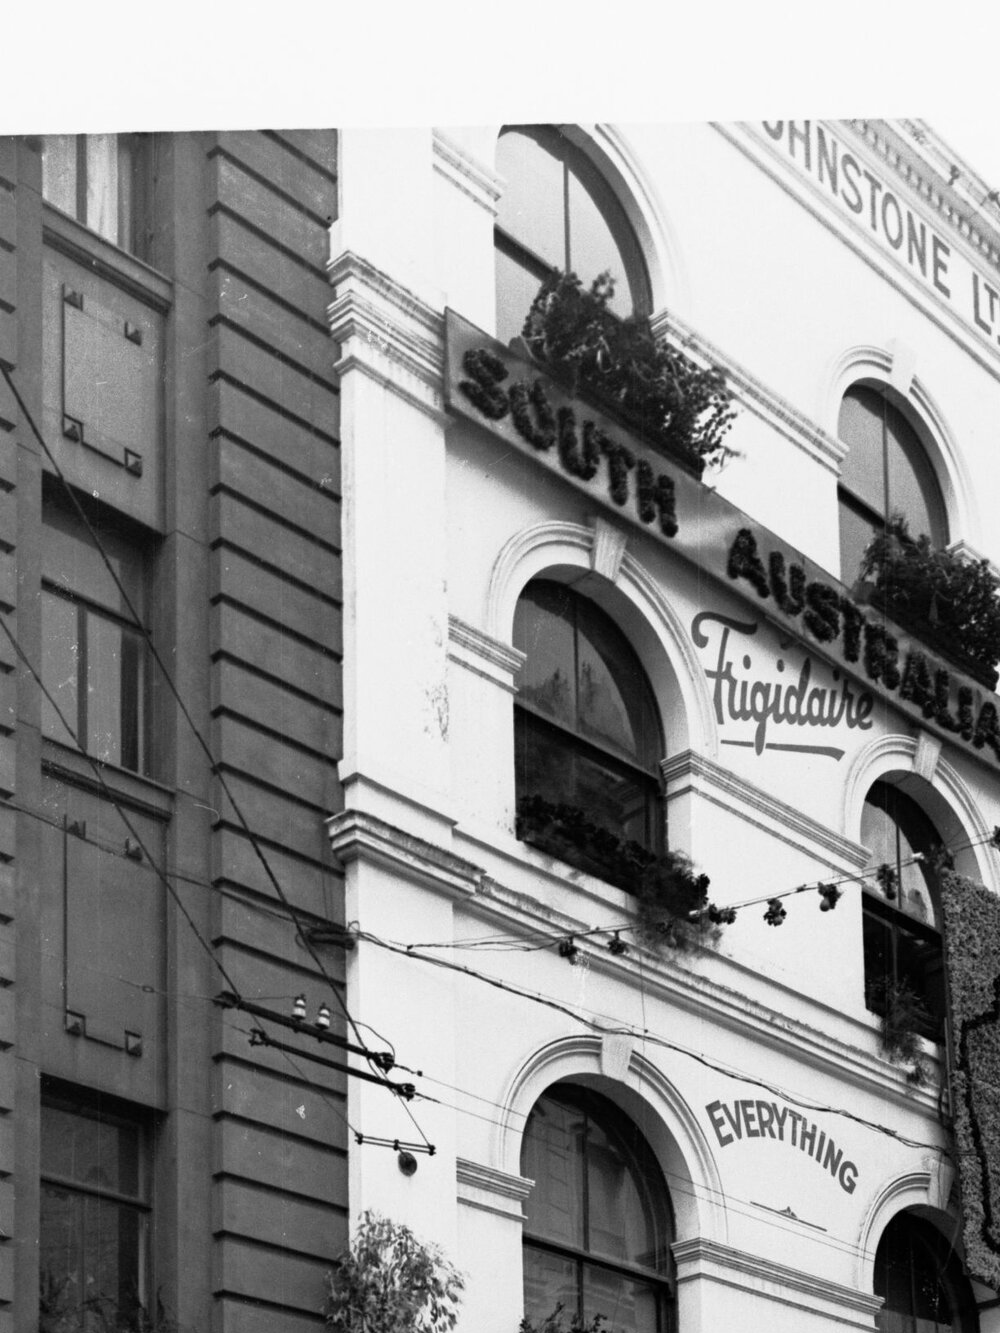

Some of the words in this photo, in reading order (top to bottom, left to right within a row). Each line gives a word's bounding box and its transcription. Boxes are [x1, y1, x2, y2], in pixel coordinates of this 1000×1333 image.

[458, 348, 678, 538] SOUTH
[691, 610, 873, 756] Frigidaire
[705, 1100, 859, 1195] EVERYTHING
